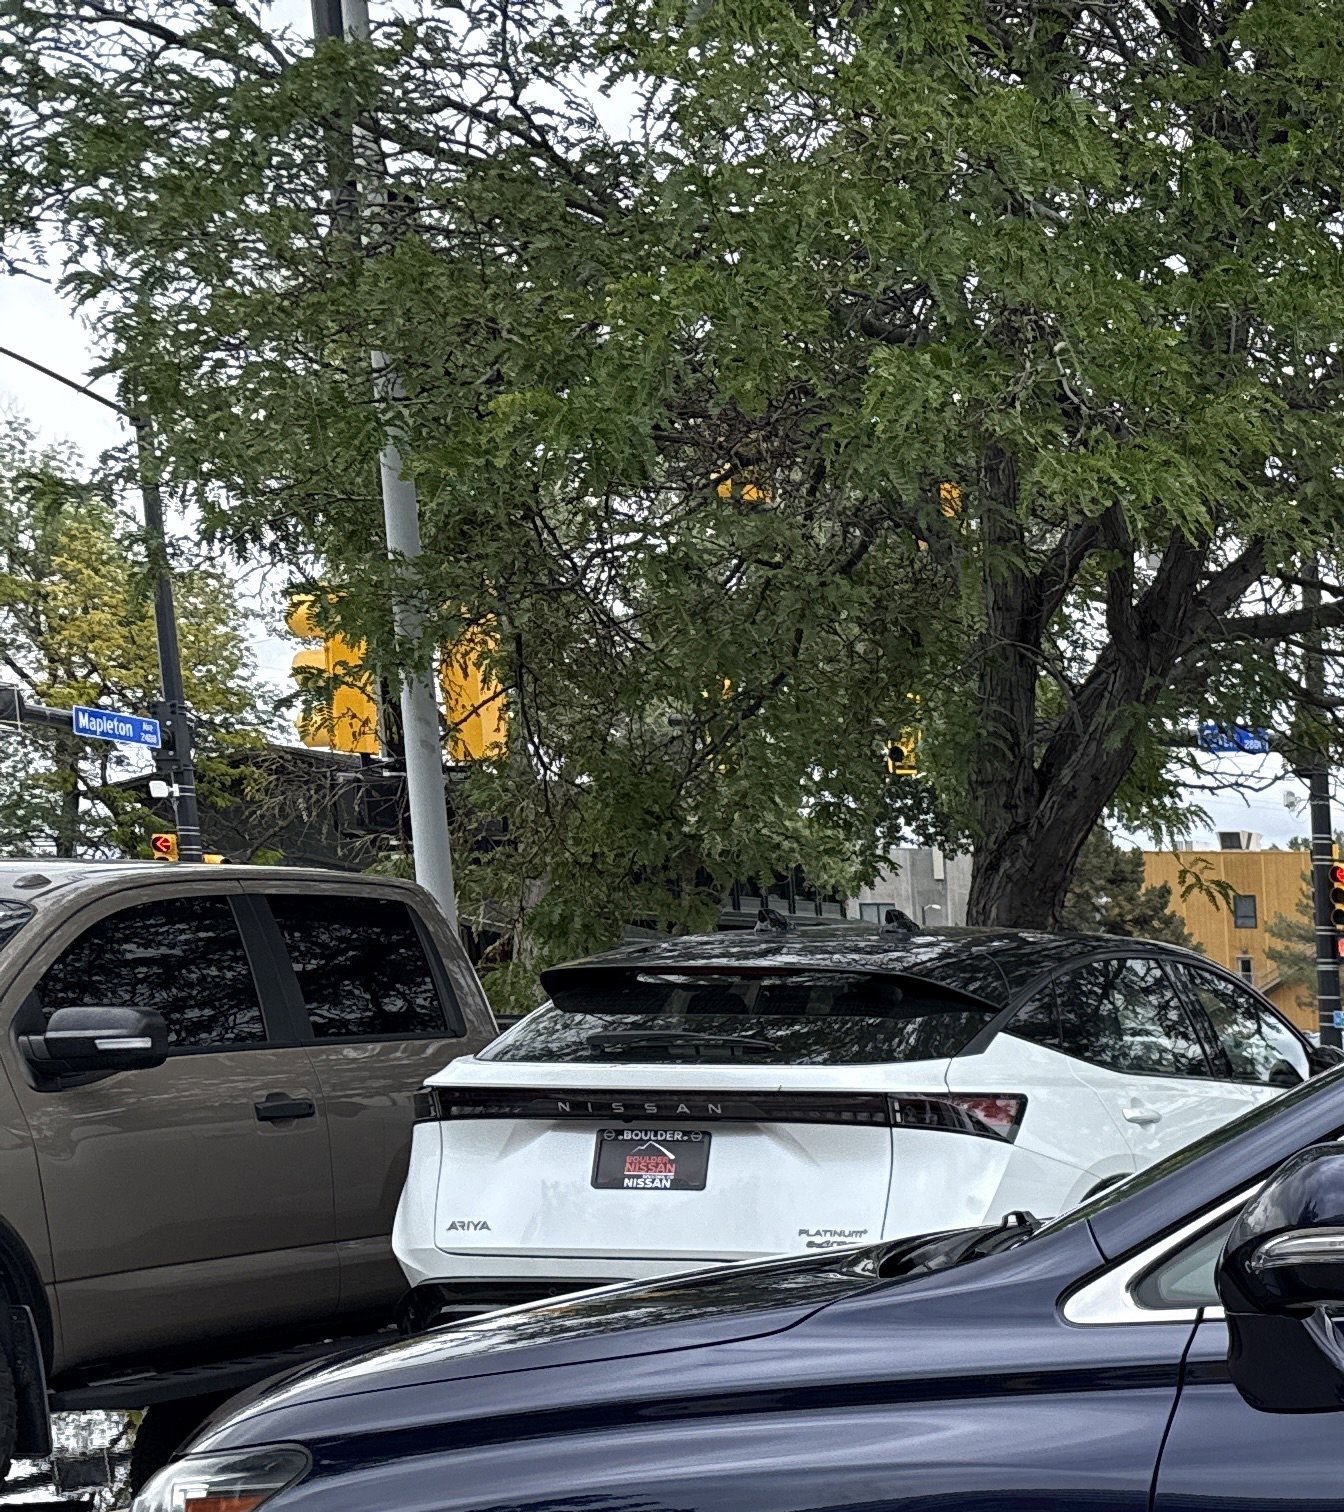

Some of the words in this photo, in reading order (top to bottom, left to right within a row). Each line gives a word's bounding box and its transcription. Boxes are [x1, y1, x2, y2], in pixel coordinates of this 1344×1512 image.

[78, 711, 133, 737] Mapleton
[558, 1102, 722, 1114] NISSAN
[623, 1130, 683, 1141] BOULDER
[625, 1163, 676, 1172] NISSAN
[623, 1178, 671, 1188] NISSAN
[446, 1220, 491, 1231] ARIYA
